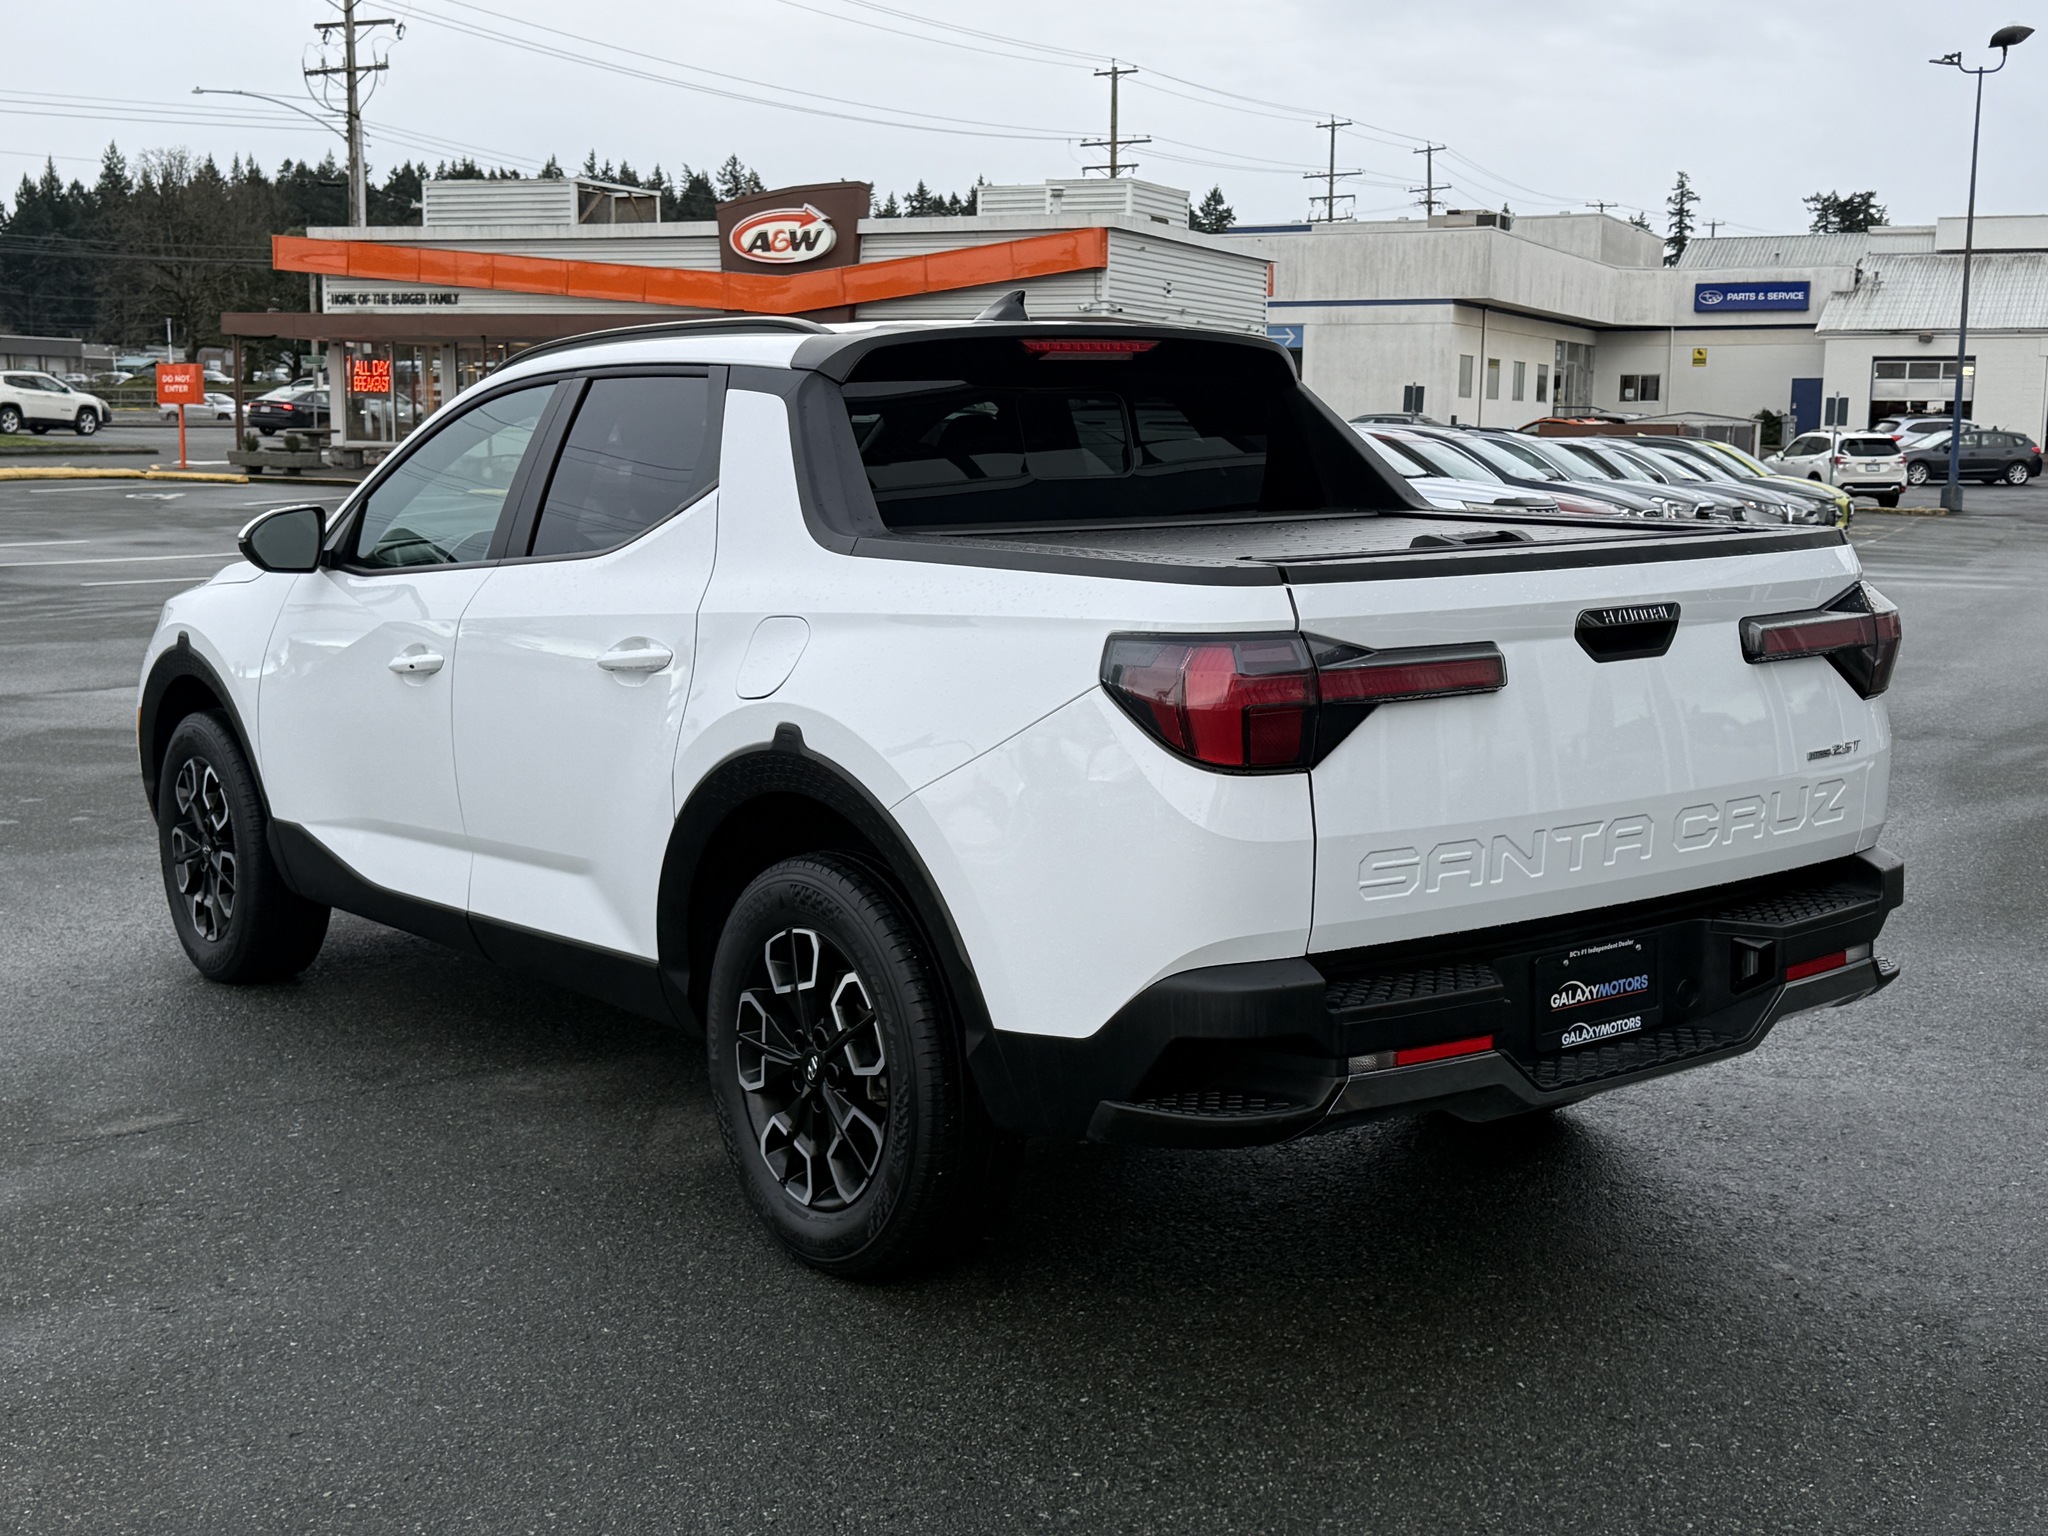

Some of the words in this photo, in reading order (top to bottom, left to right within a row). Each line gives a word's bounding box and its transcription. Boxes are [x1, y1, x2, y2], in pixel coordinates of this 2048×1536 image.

[746, 229, 825, 253] A&W
[331, 293, 356, 305] HOME
[357, 293, 371, 305] OF
[372, 293, 389, 305] THE
[391, 293, 426, 305] BURGER
[428, 293, 460, 305] FAMILY
[1727, 292, 1756, 301] PARTS
[1758, 291, 1764, 300] &
[1767, 291, 1804, 300] SERVICE
[354, 360, 371, 375] ALL
[372, 360, 390, 375] DAY
[162, 375, 174, 383] DO
[174, 375, 190, 383] NOT
[164, 385, 189, 393] ENTER
[1603, 605, 1669, 624] HYUNDAI
[1358, 813, 1656, 902] SANTA
[1672, 778, 1847, 854] CRUZ
[1587, 942, 1618, 954] Independent
[1618, 938, 1635, 948] Dealer
[1561, 1015, 1642, 1046] GALAXYMOTORS
